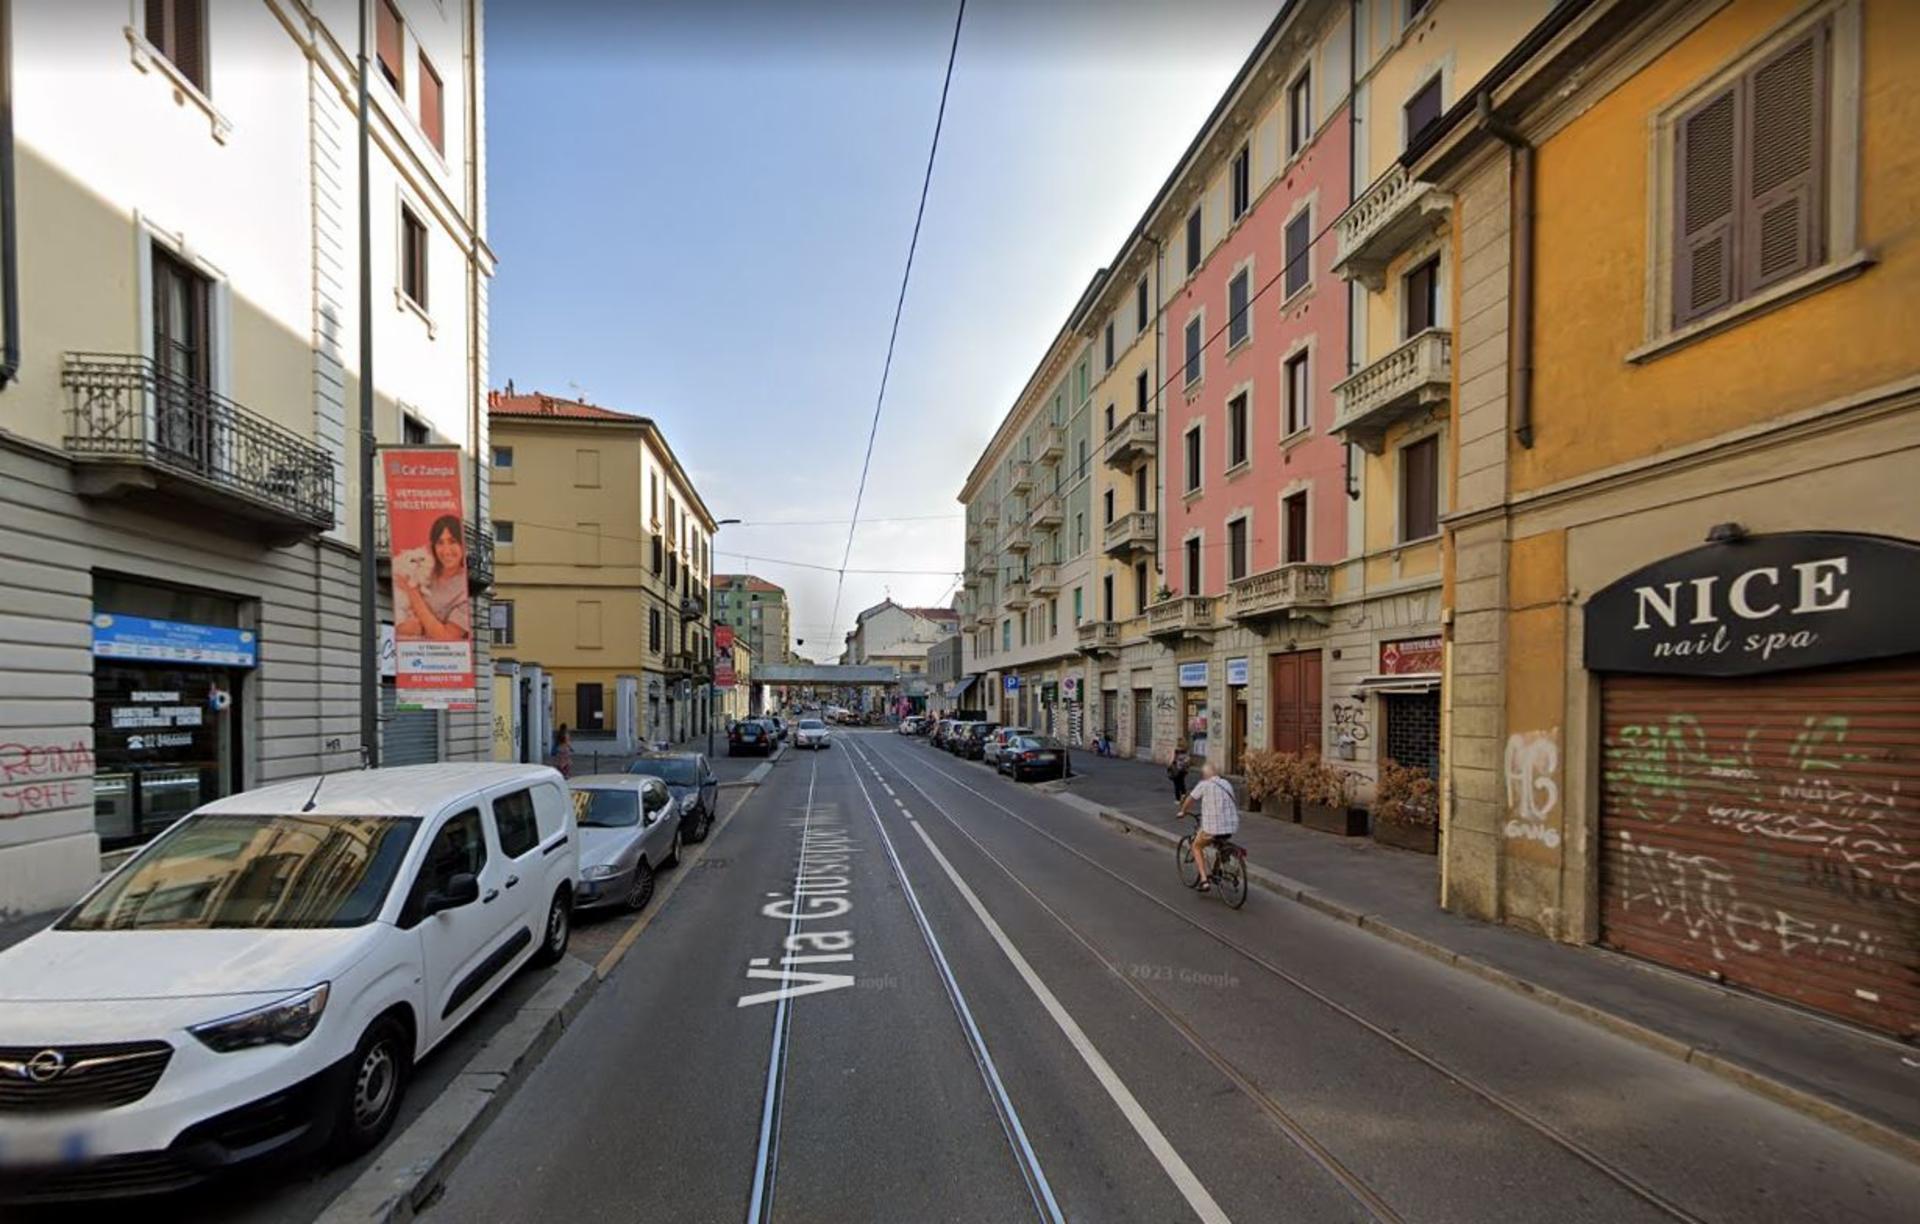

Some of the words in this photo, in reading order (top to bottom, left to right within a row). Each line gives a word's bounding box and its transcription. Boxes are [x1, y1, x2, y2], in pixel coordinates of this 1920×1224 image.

[1633, 557, 1850, 630] NICE
[1654, 625, 1730, 656] nail
[1744, 629, 1818, 660] spa
